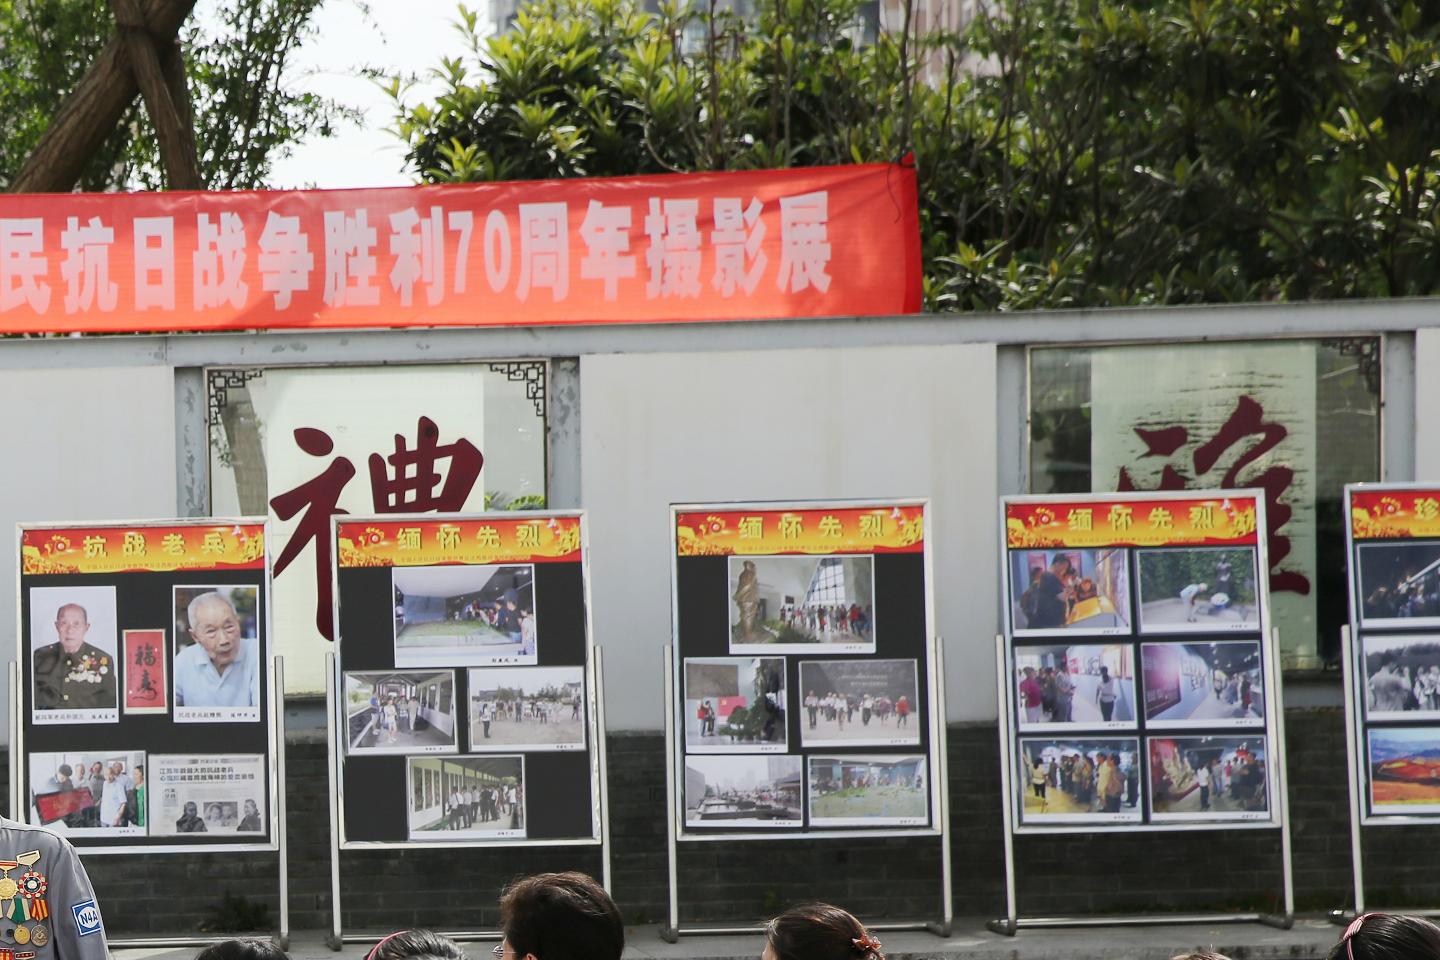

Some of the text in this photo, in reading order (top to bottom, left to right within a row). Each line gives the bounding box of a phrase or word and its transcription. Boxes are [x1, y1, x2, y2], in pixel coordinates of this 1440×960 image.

[738, 515, 884, 539] 缅怀先烈
[1067, 506, 1214, 531] 缅怀先烈
[82, 533, 226, 559] 抗战老兵
[397, 524, 541, 550] 缅怀先烈
[79, 910, 99, 925] N4A
